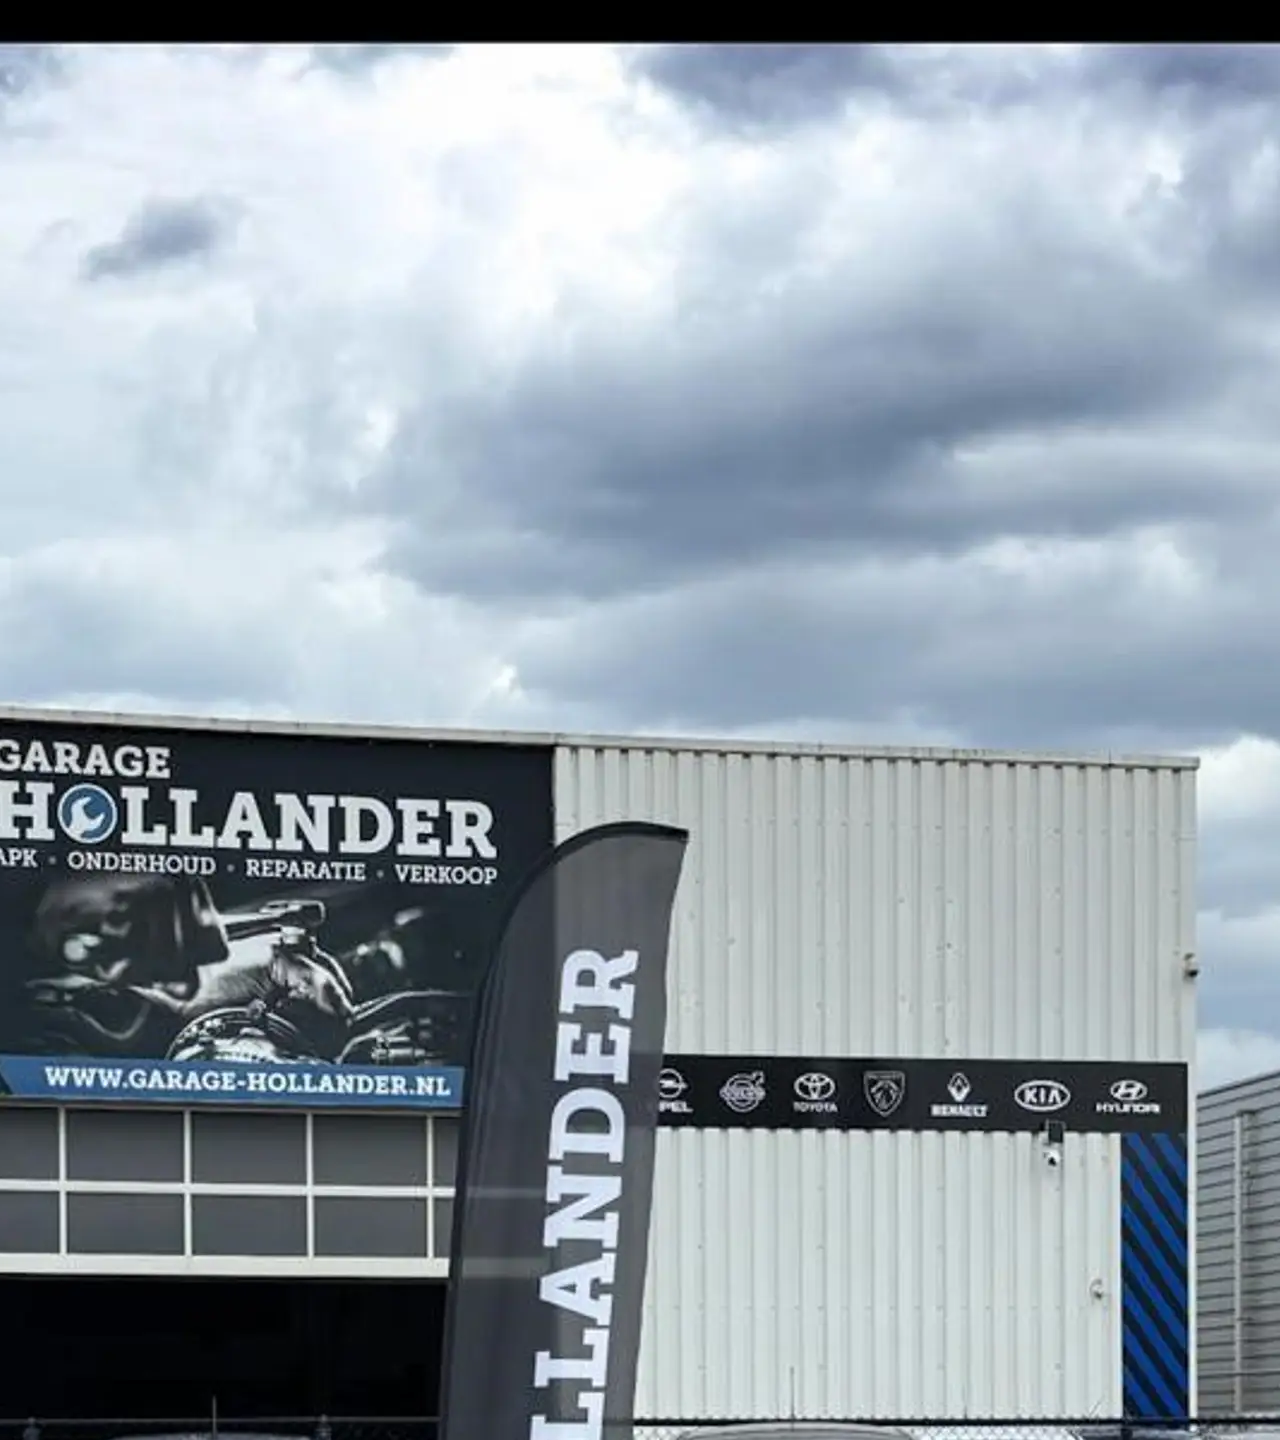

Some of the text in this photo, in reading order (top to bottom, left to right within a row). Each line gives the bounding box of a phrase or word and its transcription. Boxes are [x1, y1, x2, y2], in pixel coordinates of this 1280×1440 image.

[67, 850, 217, 876] ONDERHOUD
[245, 858, 367, 882] REPARATIE
[394, 863, 498, 885] VERKOOP
[44, 1066, 452, 1097] WWW.GARAGE-HOLLANDER.NL
[1023, 1092, 1062, 1105] KIA
[658, 1100, 694, 1113] PEL
[793, 1101, 838, 1113] TOYOTA
[931, 1104, 988, 1117] RENAULT
[1095, 1102, 1161, 1114] HYUNDAI
